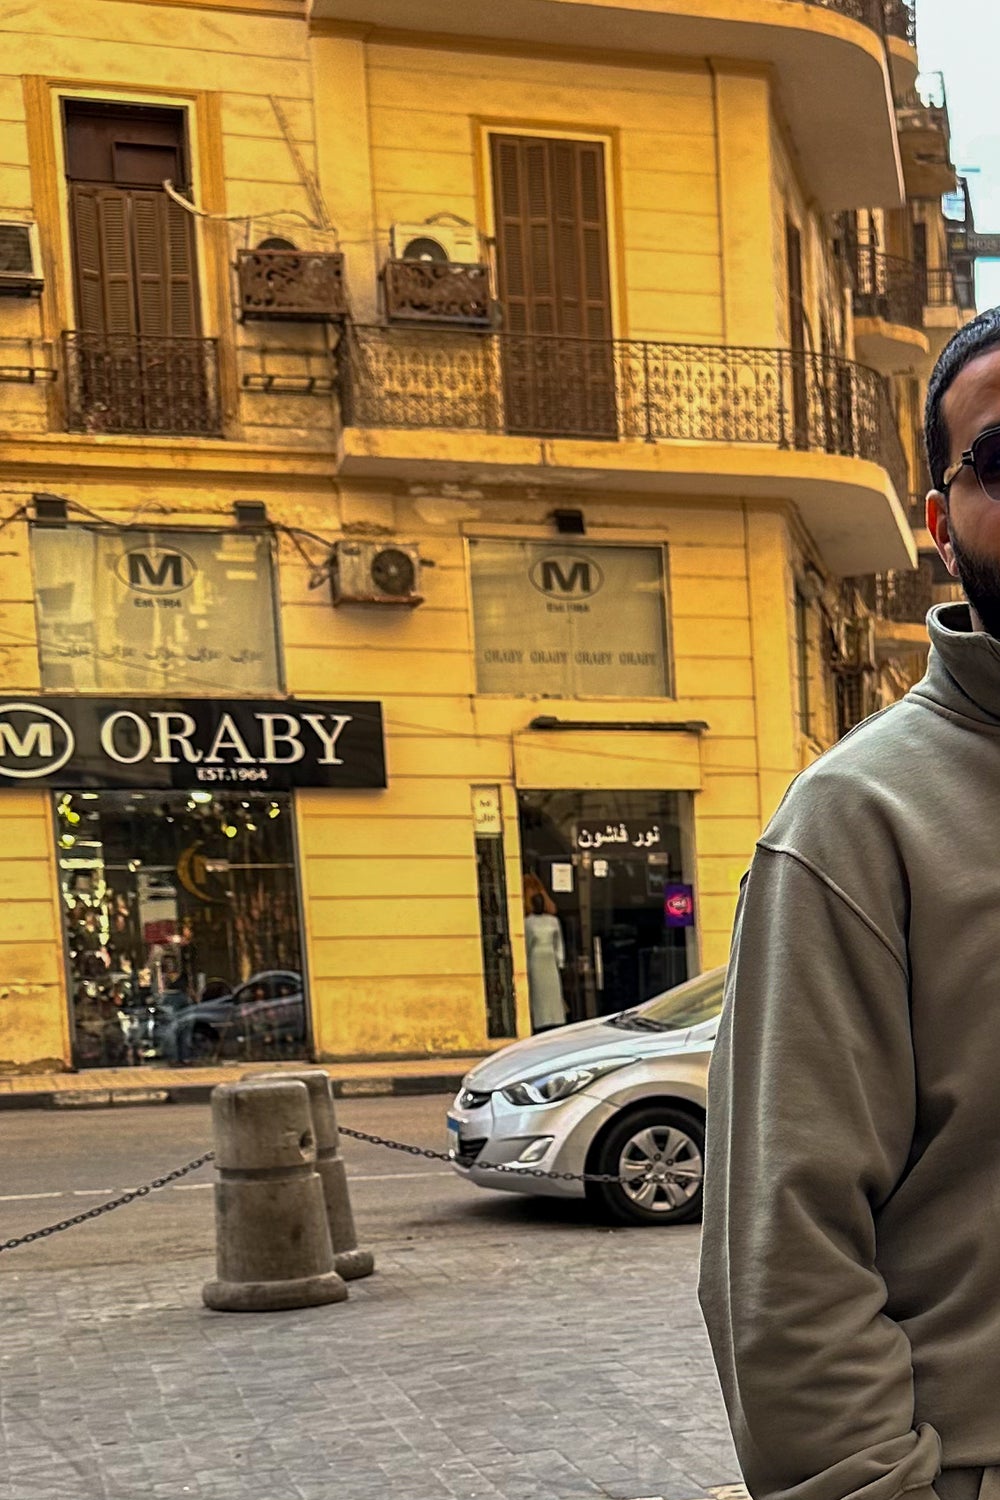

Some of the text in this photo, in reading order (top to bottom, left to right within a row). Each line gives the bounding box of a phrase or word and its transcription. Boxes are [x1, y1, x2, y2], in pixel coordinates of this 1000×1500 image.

[128, 553, 183, 586] M
[541, 561, 591, 593] M
[0, 711, 352, 765] M ORABY
[578, 823, 660, 848] نور فاشون
